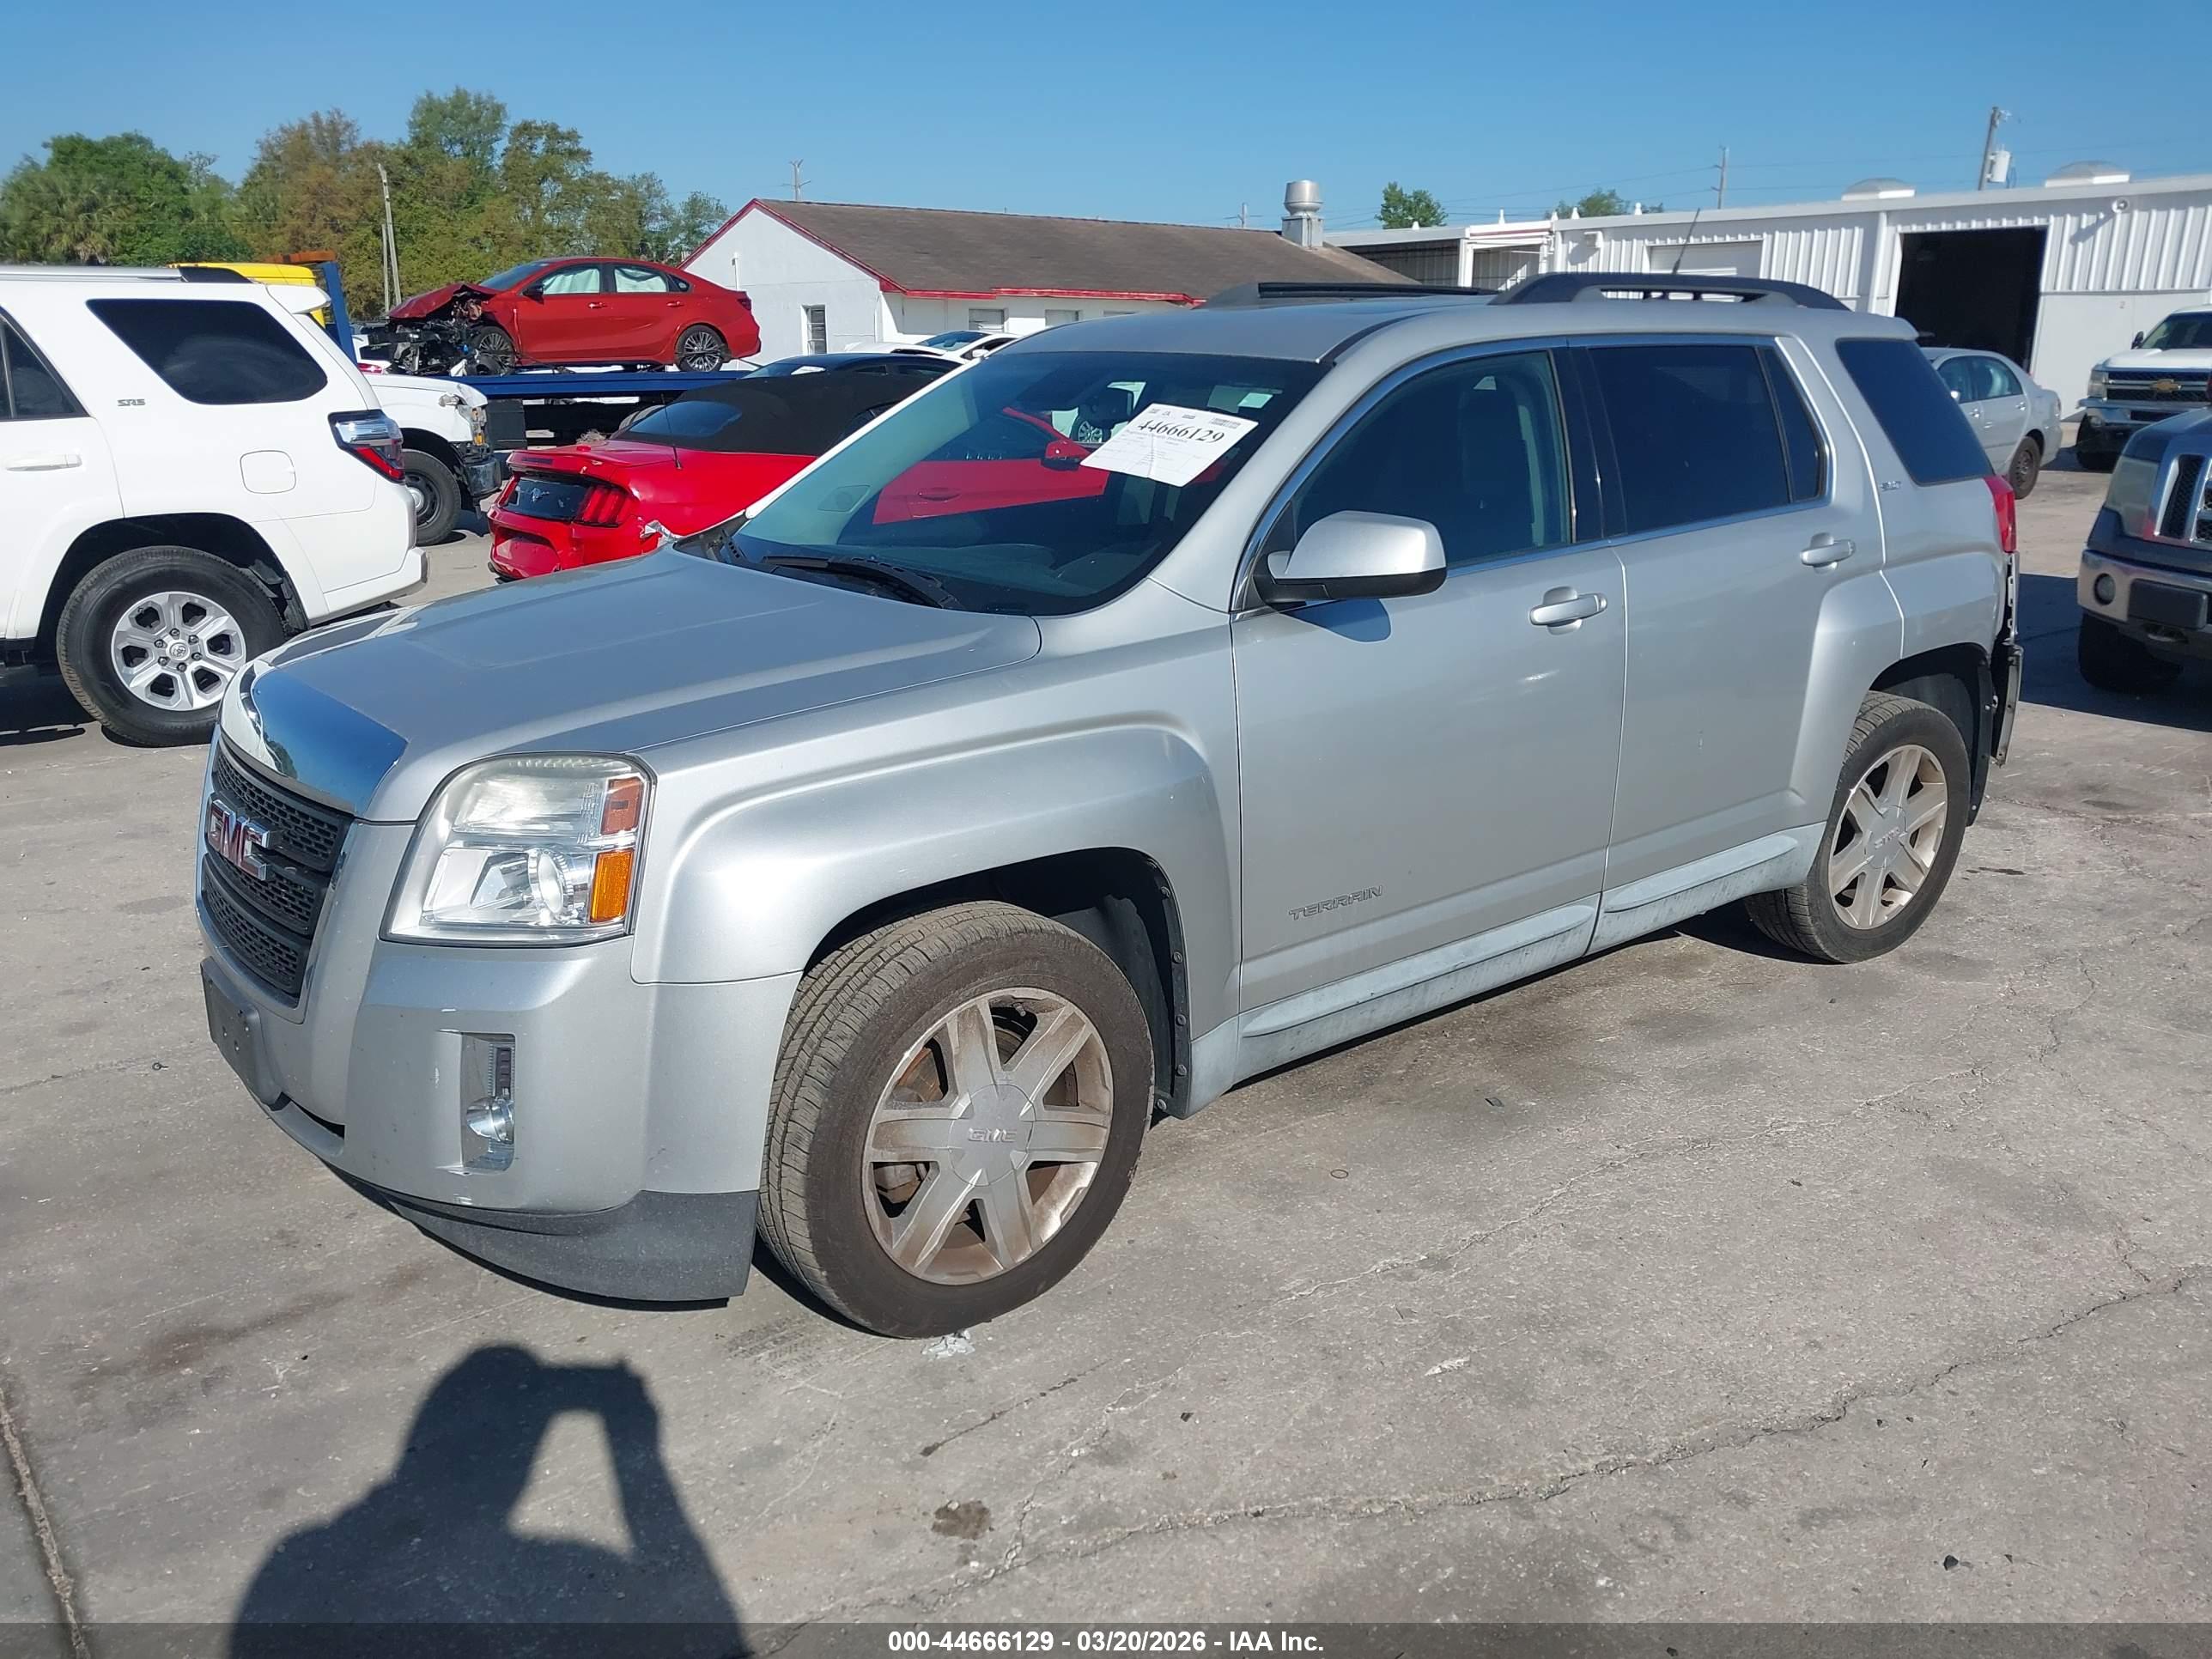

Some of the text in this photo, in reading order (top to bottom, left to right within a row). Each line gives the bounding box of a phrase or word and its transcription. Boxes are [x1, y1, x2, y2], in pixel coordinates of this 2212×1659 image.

[1138, 419, 1225, 444] 44666129
[207, 798, 270, 882] GMC
[1289, 885, 1383, 921] TERRAIN
[968, 1127, 1017, 1143] GMC
